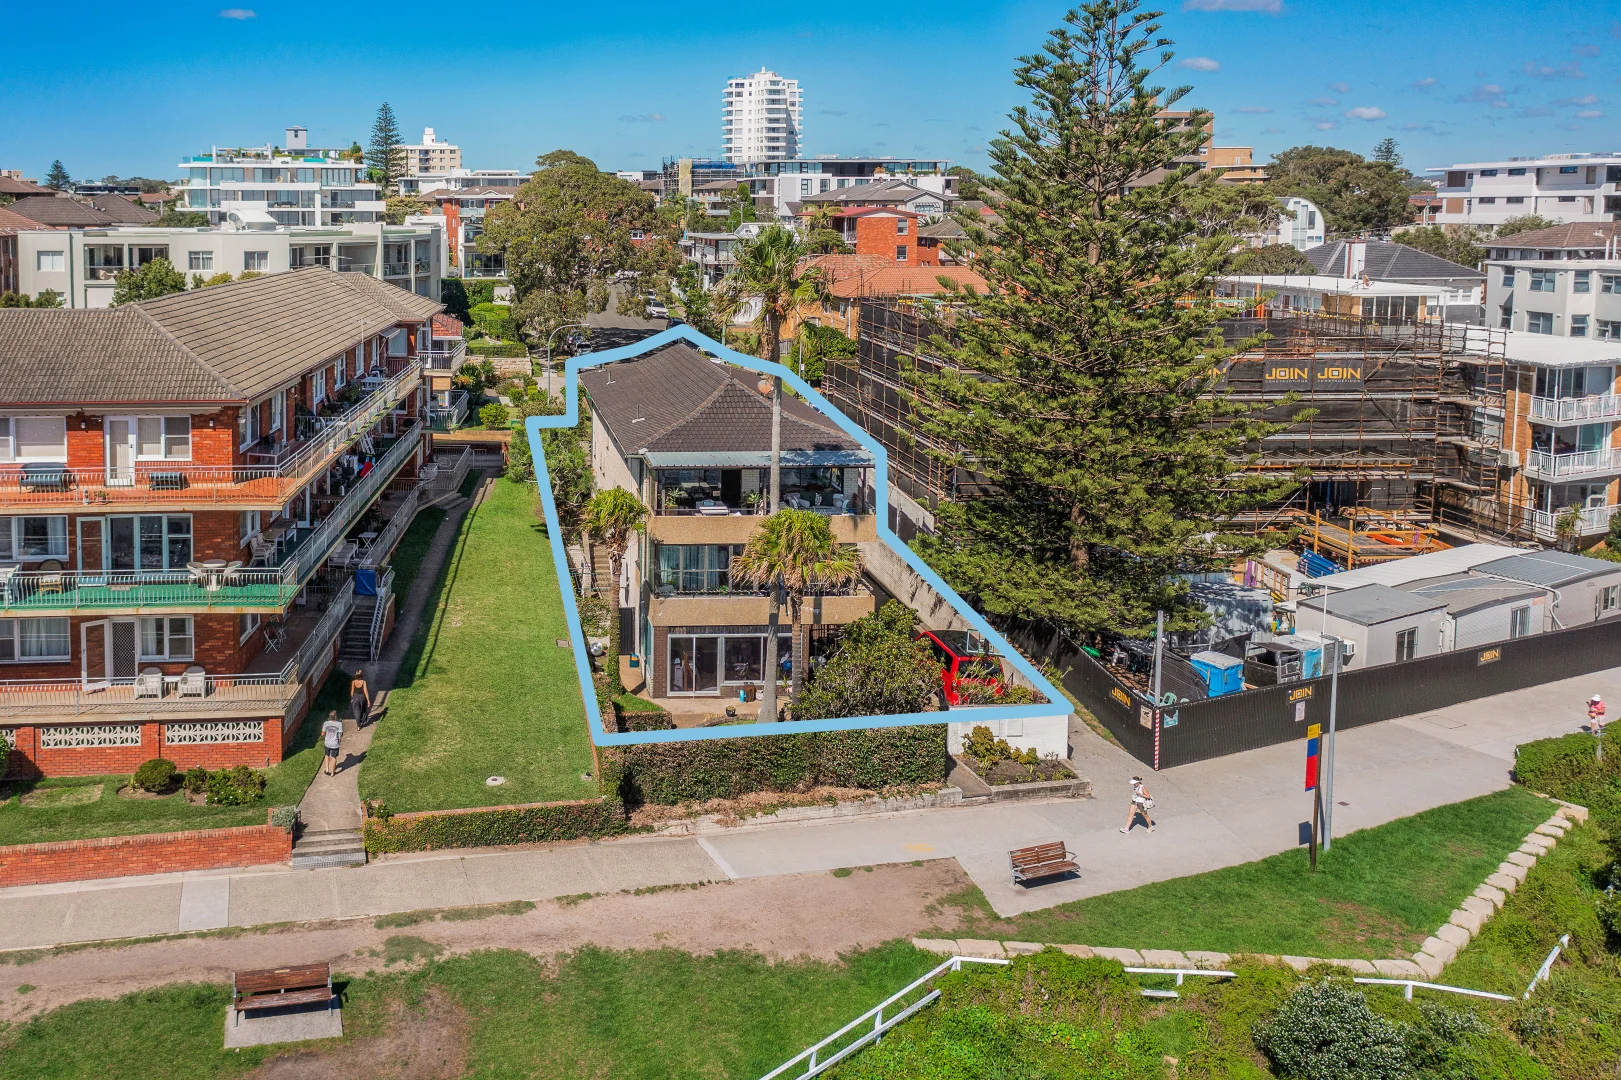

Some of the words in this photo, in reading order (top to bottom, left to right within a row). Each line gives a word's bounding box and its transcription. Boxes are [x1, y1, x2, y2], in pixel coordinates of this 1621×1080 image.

[1265, 367, 1308, 380] JOIN
[1317, 367, 1361, 379] JOIN
[1480, 649, 1499, 661] JOIN
[1111, 686, 1131, 707] JOIN
[1289, 686, 1312, 701] JOIN
